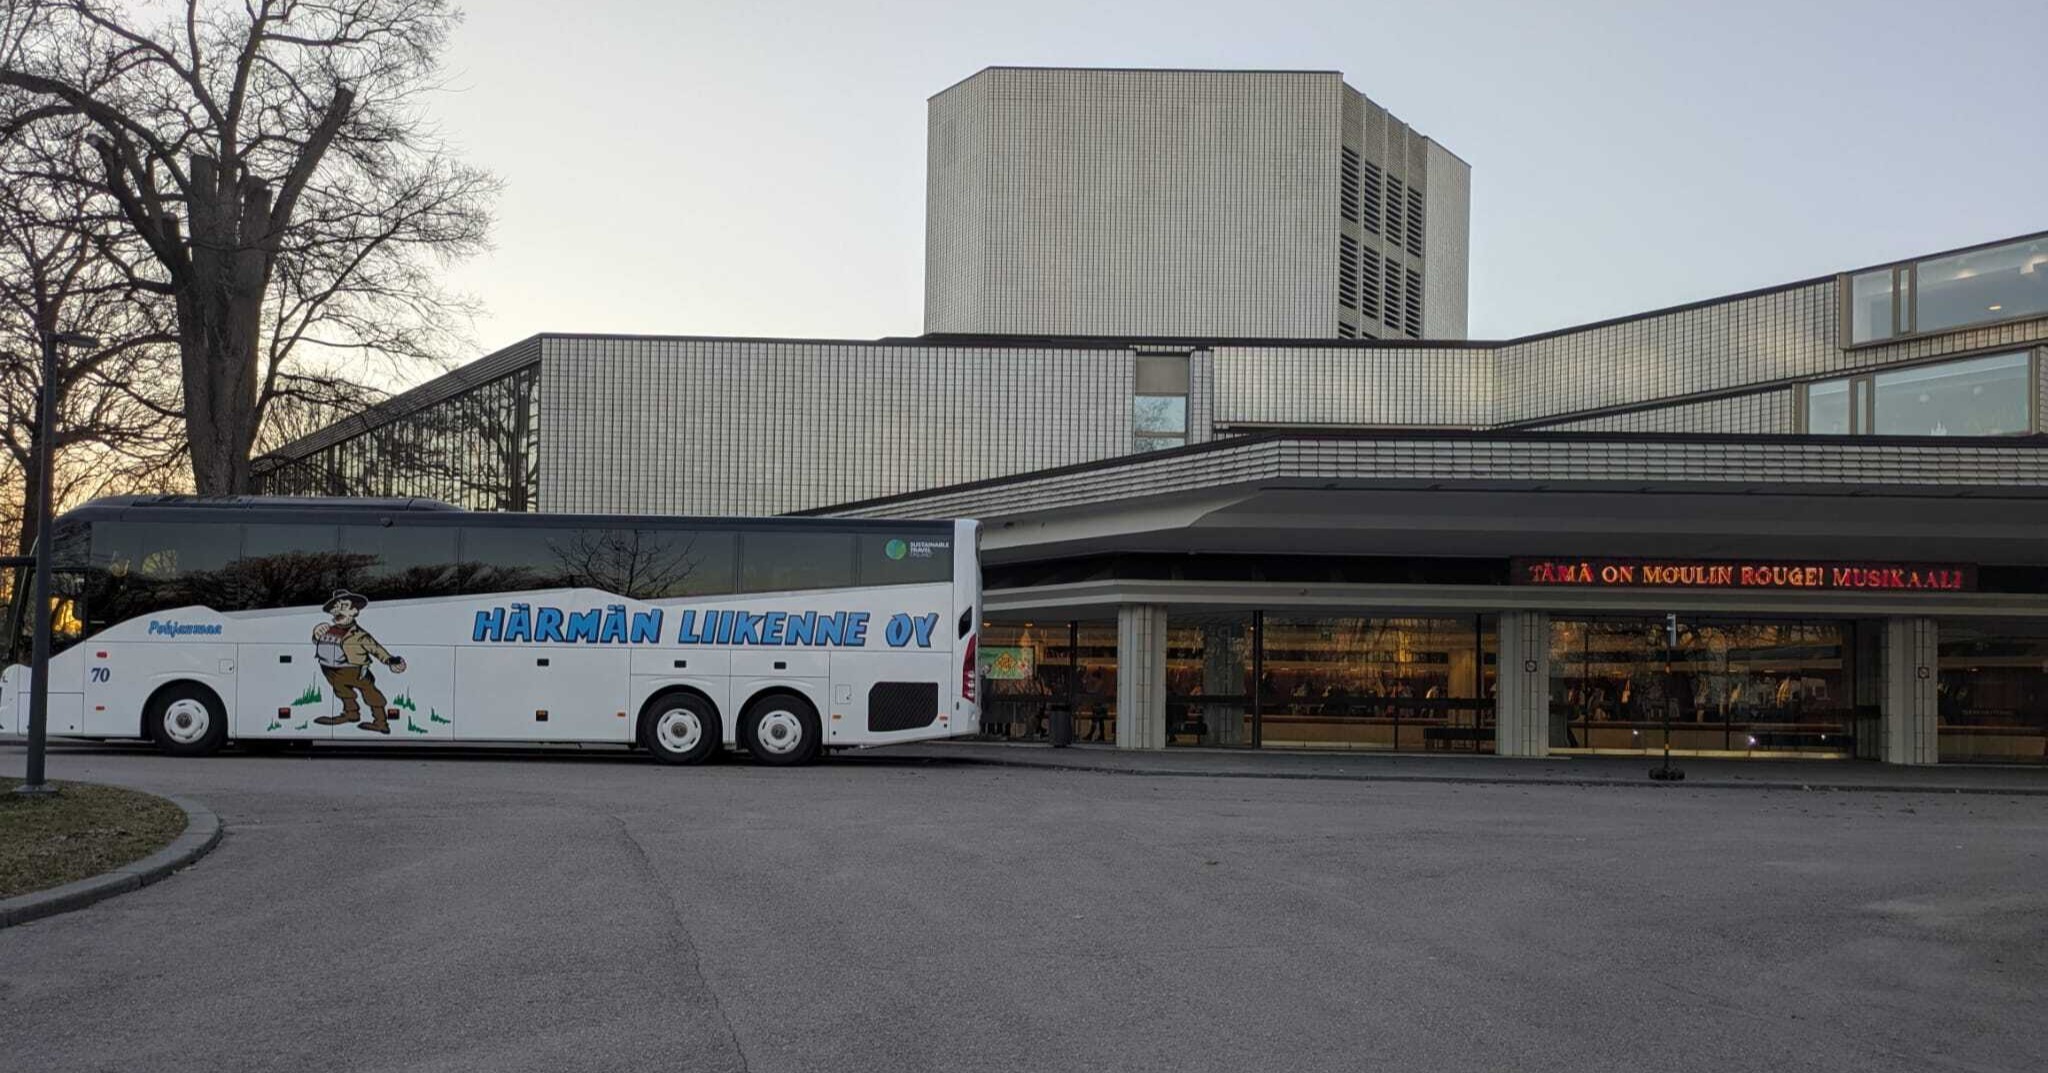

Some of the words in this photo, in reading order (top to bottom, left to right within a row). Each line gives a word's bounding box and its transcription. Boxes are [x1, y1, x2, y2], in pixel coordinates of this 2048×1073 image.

[1529, 562, 1593, 583] TÄMÄ
[1601, 565, 1635, 583] ON
[1642, 565, 1734, 585] MOULIN
[1740, 566, 1823, 587] ROUGE!
[1832, 567, 1963, 588] MUSIKAALI
[472, 603, 664, 644] HÄRMÄN
[678, 609, 870, 646] LIIKENNE
[885, 612, 939, 648] OY
[91, 667, 110, 683] 70
